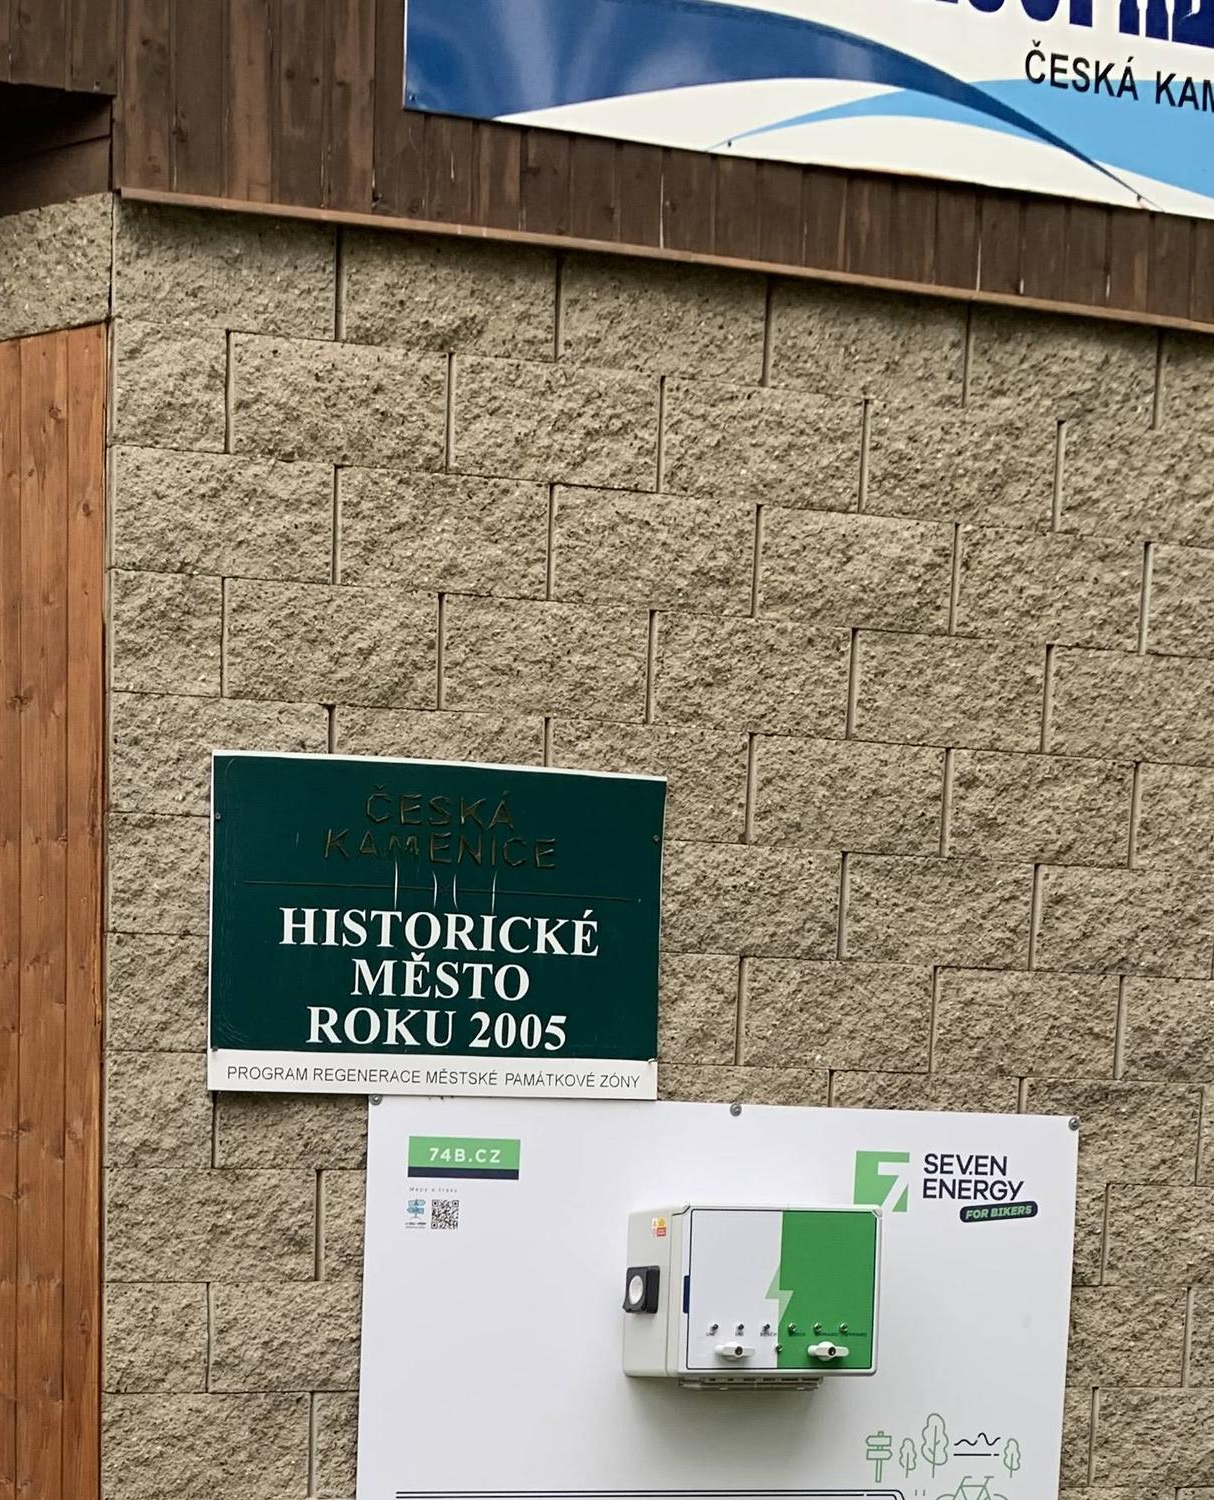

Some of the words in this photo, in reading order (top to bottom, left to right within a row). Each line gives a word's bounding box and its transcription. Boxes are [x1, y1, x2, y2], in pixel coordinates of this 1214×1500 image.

[1025, 39, 1138, 101] ČESKÁ
[365, 785, 515, 830] ČESKÁ
[323, 828, 556, 868] KAMENICE
[279, 907, 598, 956] HISTORICKÉ
[350, 952, 530, 1001] MĚSTO
[306, 1006, 456, 1047] ROKU
[468, 1012, 567, 1051] 2005
[227, 1066, 308, 1082] PROGRAM
[314, 1068, 420, 1084] REGENERACE
[425, 1067, 497, 1086] MĚSTSKÉ
[505, 1070, 595, 1088] PAMÁTKOVÉ
[600, 1072, 640, 1089] ZÓNY
[429, 1147, 501, 1163] 74B.CZ
[923, 1178, 1025, 1201] ENERGY
[966, 1208, 990, 1219] FOR
[990, 1205, 1033, 1217] BIKERS
